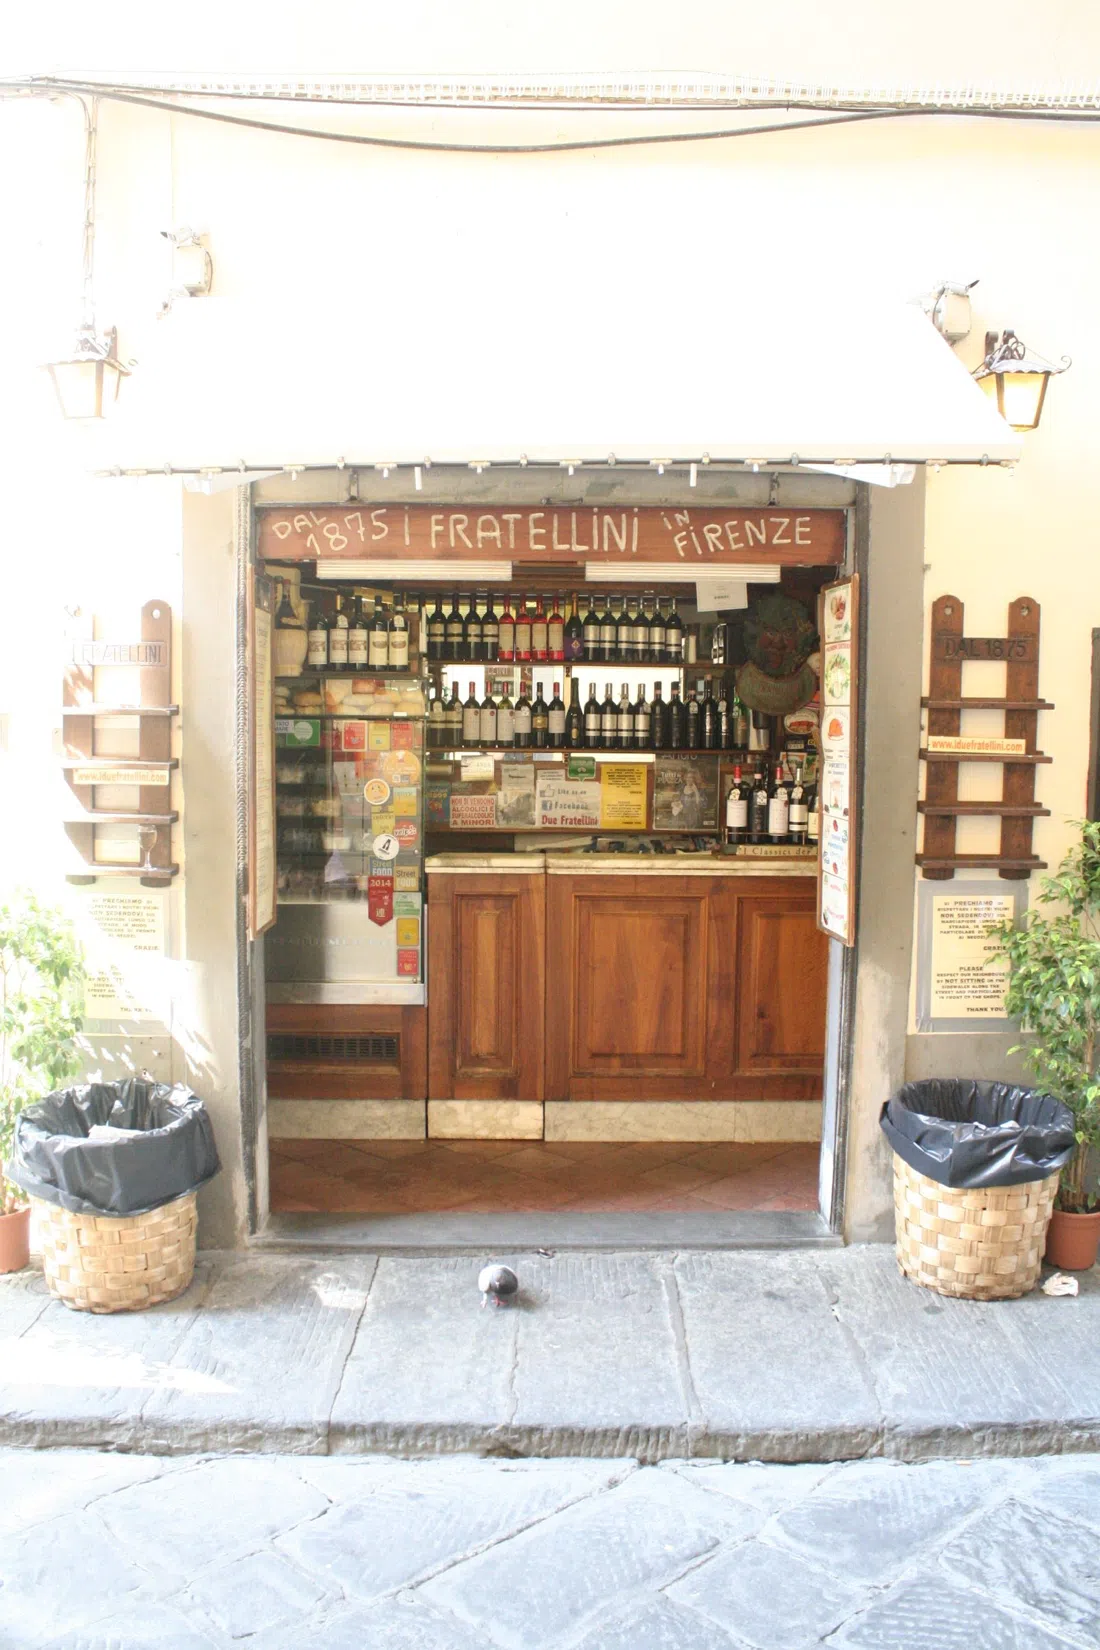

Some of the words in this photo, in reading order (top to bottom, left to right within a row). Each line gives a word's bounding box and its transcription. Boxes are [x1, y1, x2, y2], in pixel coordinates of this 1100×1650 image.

[272, 511, 326, 540] DAL
[306, 509, 388, 555] 1875
[430, 507, 639, 552] FRATELLINI
[674, 516, 812, 558] FIRENZE
[944, 639, 981, 658] DAL
[985, 639, 1026, 658] 1875
[931, 739, 1023, 752] www.iduefratellini.com
[554, 801, 589, 810] Facebook
[542, 814, 558, 825] Due
[370, 879, 392, 888] 2014
